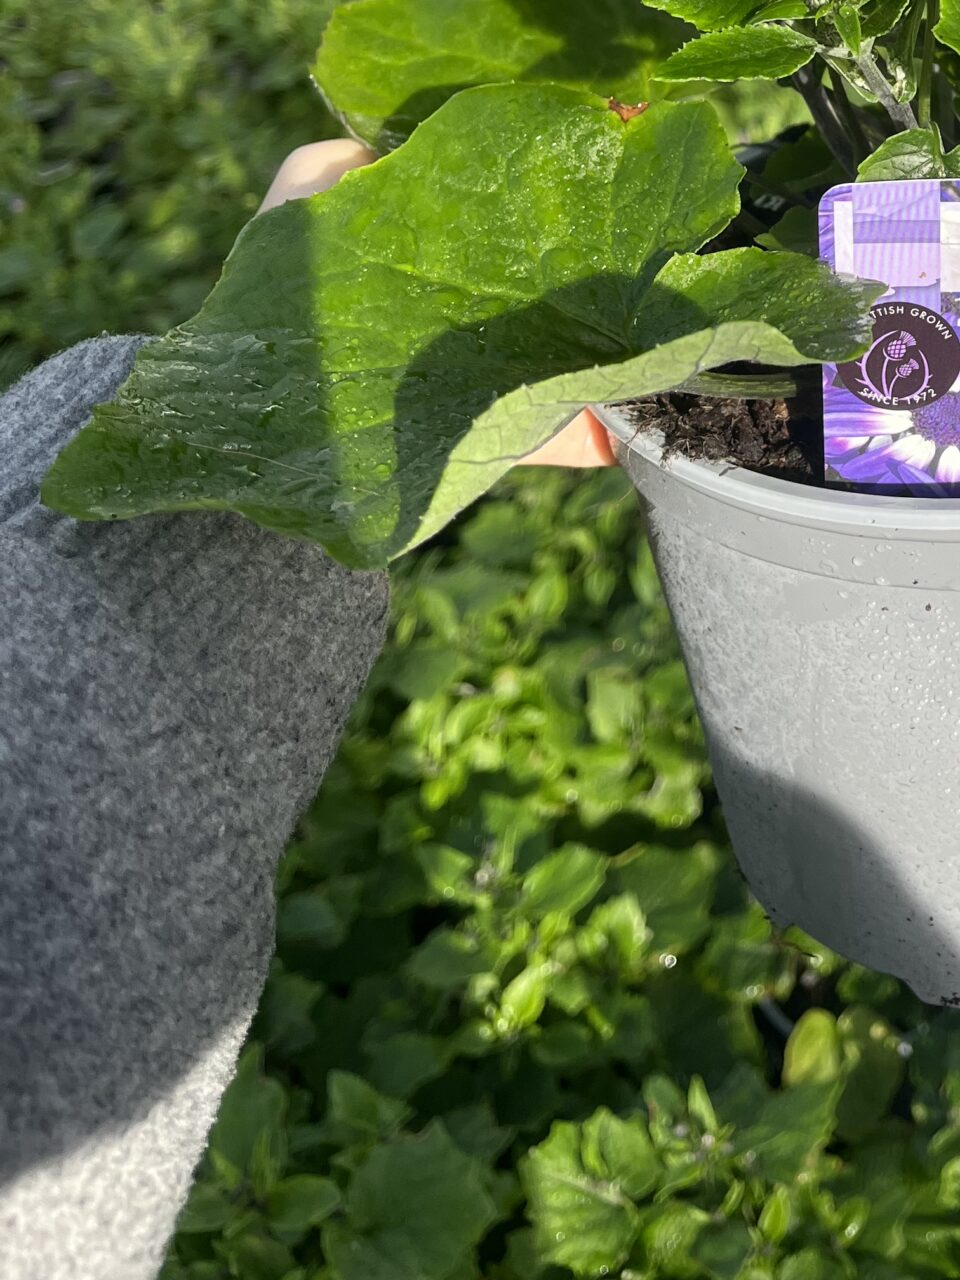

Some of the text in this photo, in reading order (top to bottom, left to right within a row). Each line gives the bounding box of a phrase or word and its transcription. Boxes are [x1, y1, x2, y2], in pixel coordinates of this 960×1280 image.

[869, 305, 953, 340] TTISH GROWN
[860, 387, 937, 405] SINCE 1972
